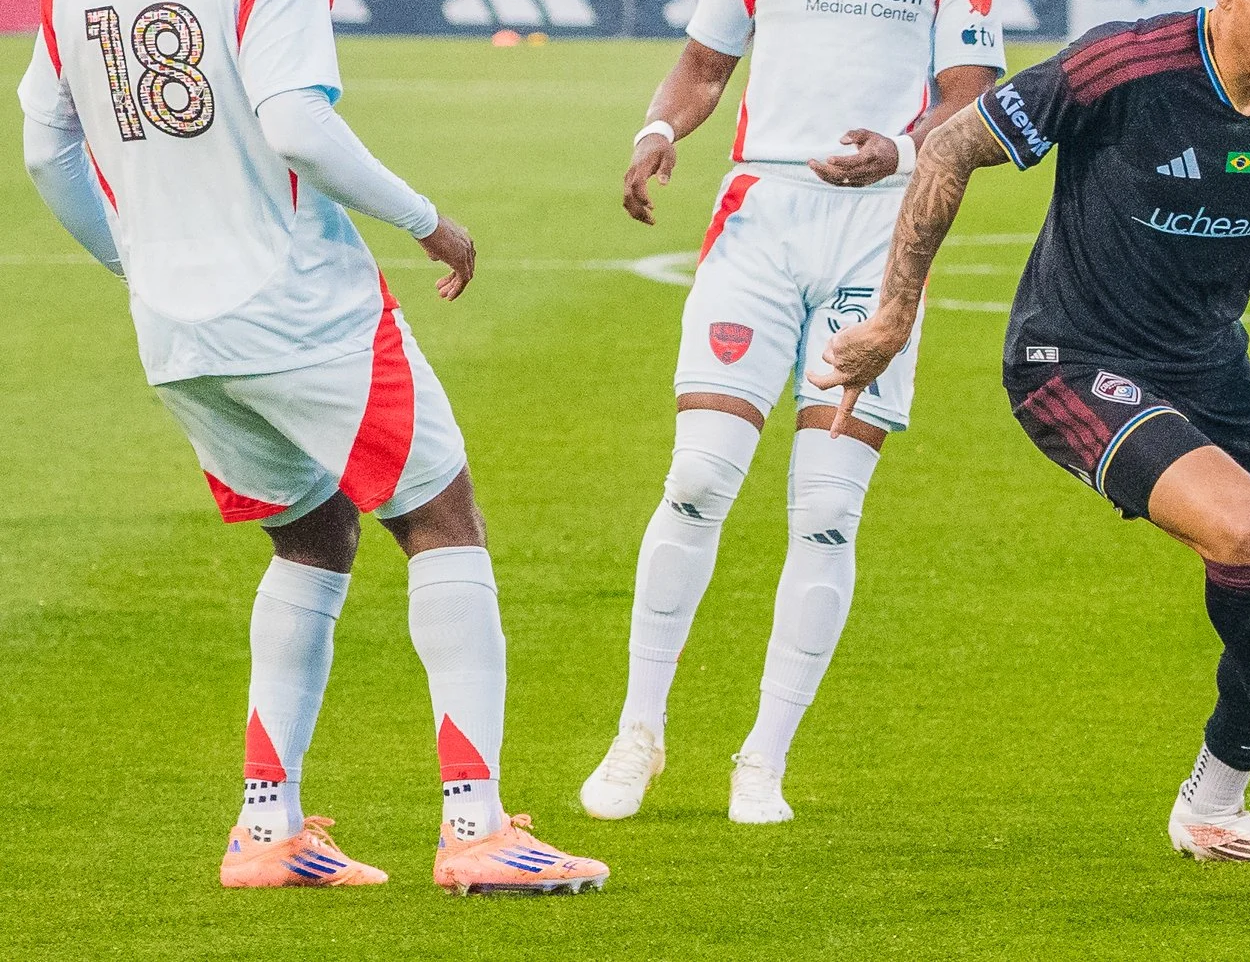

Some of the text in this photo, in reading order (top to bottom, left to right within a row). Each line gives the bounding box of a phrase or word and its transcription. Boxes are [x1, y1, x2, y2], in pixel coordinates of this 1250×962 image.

[871, 3, 919, 23] Center
[980, 26, 995, 47] tv
[84, 1, 215, 142] 18
[994, 83, 1052, 157] Kiewit
